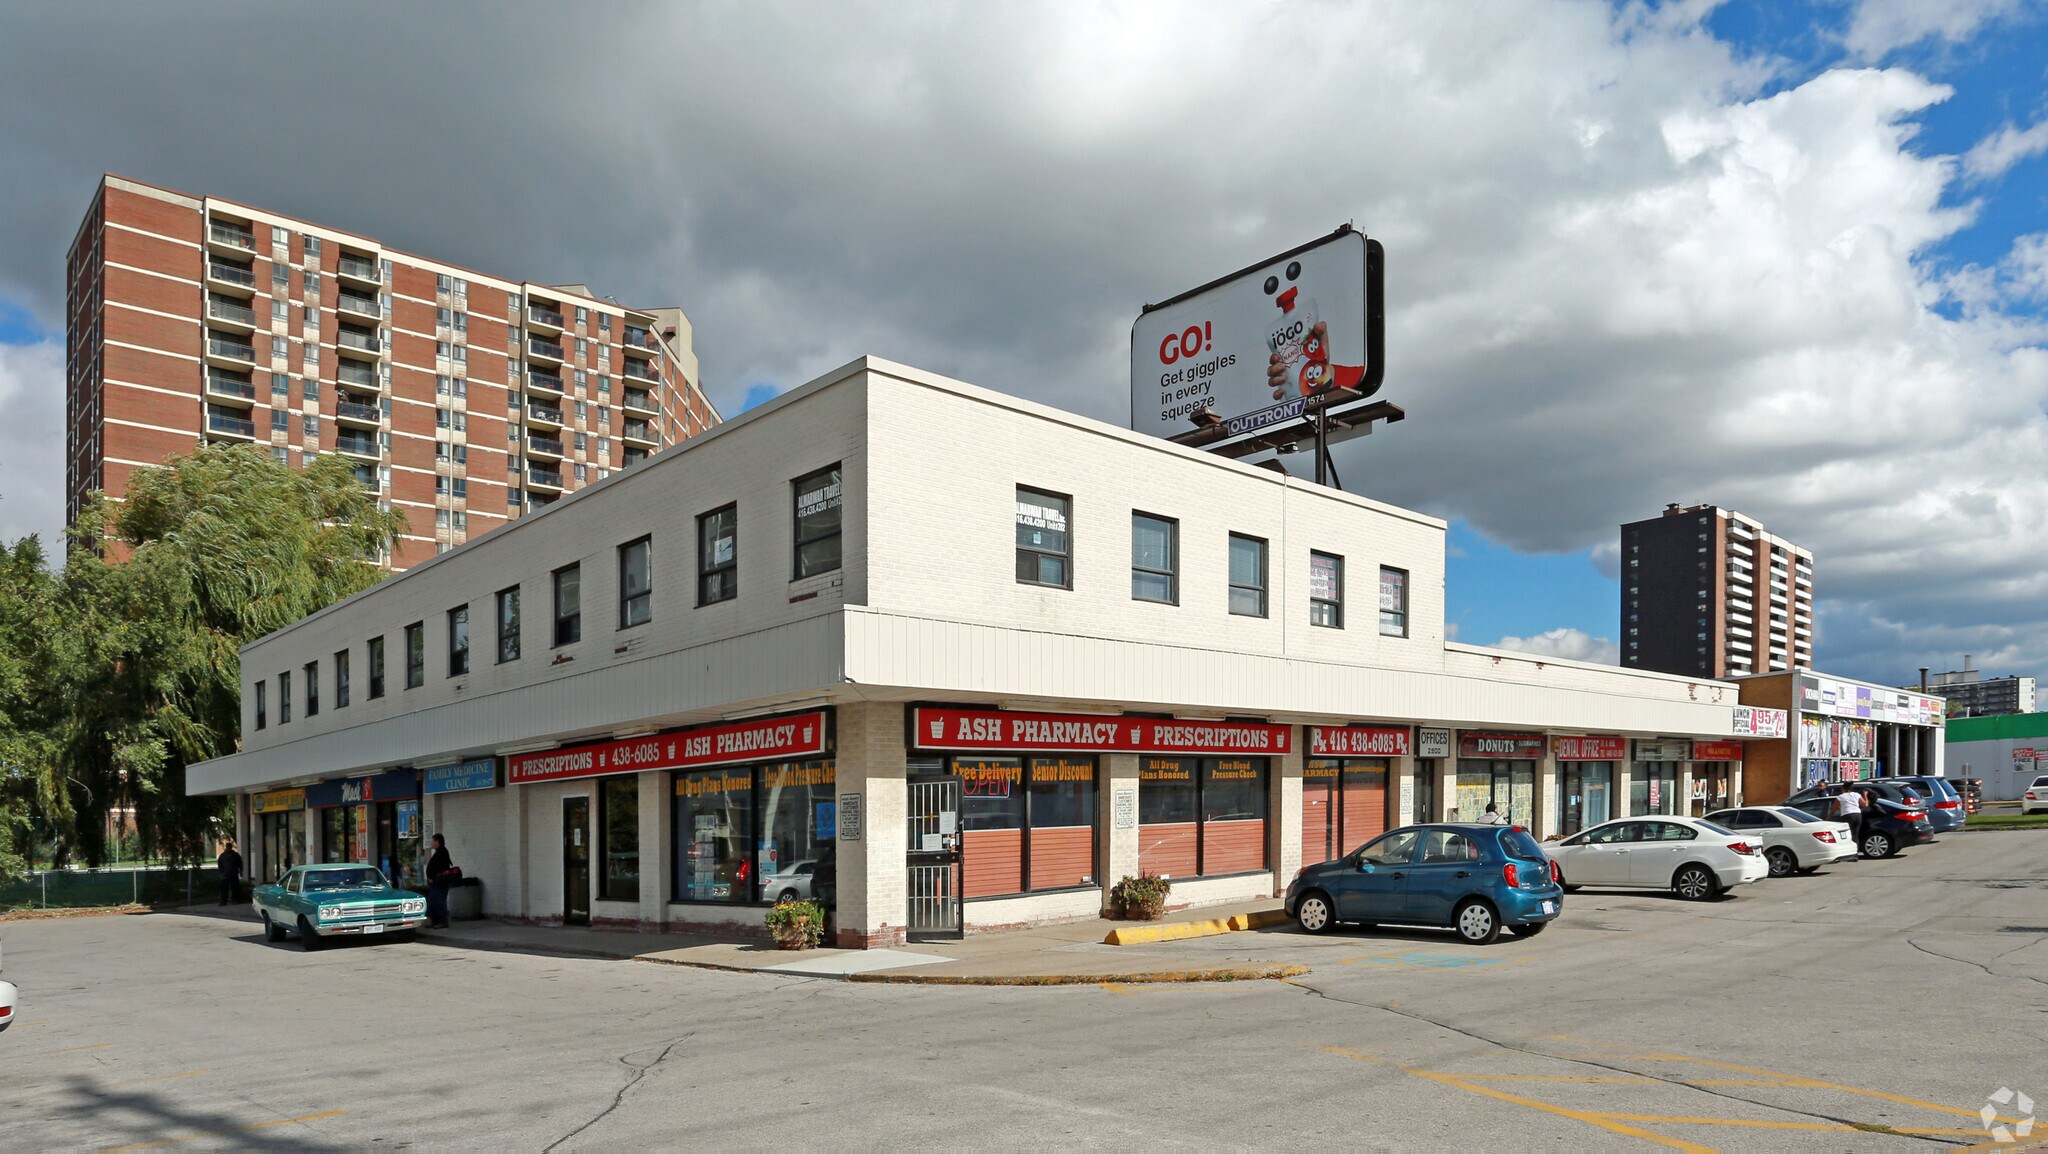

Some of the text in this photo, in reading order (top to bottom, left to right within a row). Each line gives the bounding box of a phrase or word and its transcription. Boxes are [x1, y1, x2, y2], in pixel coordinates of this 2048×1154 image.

[1159, 320, 1212, 365] GO!
[1283, 348, 1299, 360] NANO
[1160, 353, 1236, 387] Get giggles
[1160, 380, 1212, 405] in every
[1306, 393, 1325, 406] 1574
[1160, 396, 1215, 421] squeeze
[1230, 401, 1302, 433] OUTFRONT
[823, 482, 840, 500] TRAVEL
[1042, 506, 1060, 522] TRAVEL
[1733, 708, 1750, 719] LUNCH
[1733, 719, 1750, 729] SPECIAL
[684, 724, 796, 758] ASH PHARMACY
[957, 717, 1269, 748] ASH PHARMACY PRESCRIPTIONS
[1329, 730, 1348, 751] 416
[1350, 731, 1394, 753] 438-6085
[1420, 731, 1448, 745] OFFICES
[1478, 738, 1515, 753] DONUTS
[1559, 739, 1580, 757] DENTAL
[1581, 739, 1600, 758] OFFICE
[522, 742, 660, 777] PRESCRIPTIONS 438-6085
[1031, 759, 1093, 781] Senior Discount
[1149, 760, 1179, 772] All Drug
[1218, 760, 1251, 770] Free Blood
[428, 766, 453, 781] FAMILY
[764, 767, 778, 789] Free
[795, 763, 821, 786] Pressure
[952, 762, 1022, 785] Free Delivery
[1158, 769, 1189, 780] Honored
[1212, 769, 1257, 780] Pressure Check
[1809, 760, 1829, 781] RIM
[1841, 760, 1860, 781] TIRE
[445, 776, 471, 791] CLINIC
[676, 772, 751, 798] All Drug Plans Honored
[963, 771, 1009, 796] OPEN
